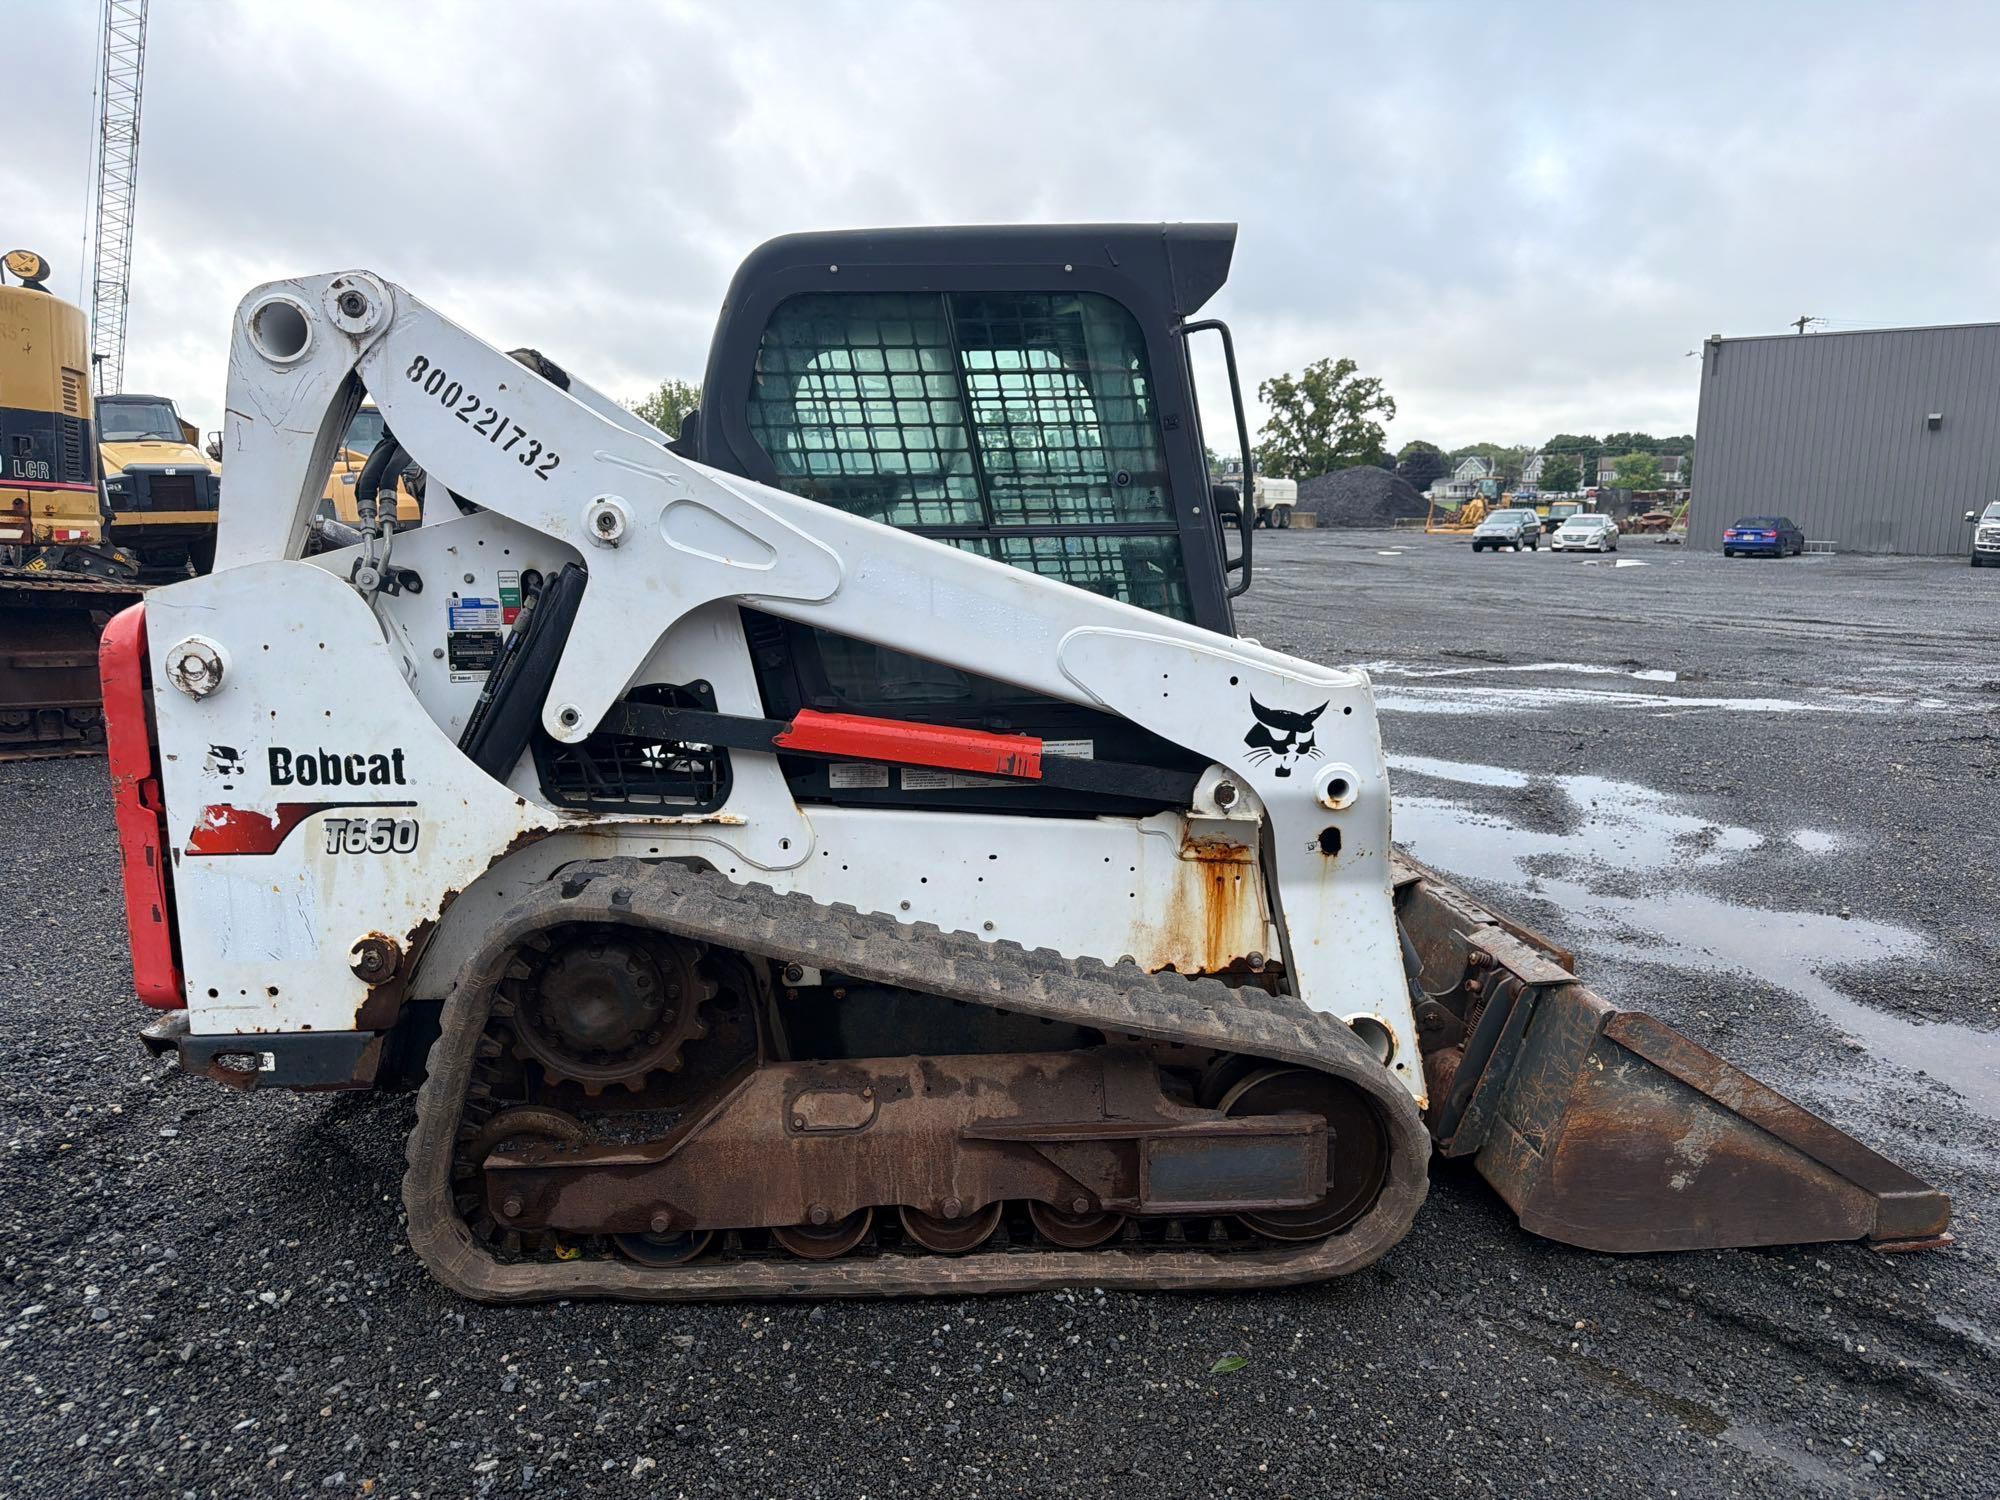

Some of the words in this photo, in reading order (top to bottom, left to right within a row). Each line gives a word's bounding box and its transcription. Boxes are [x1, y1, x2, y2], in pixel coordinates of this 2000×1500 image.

[405, 355, 560, 481] 800221732
[13, 459, 50, 480] LCR
[268, 747, 406, 786] Bobcat
[322, 818, 419, 855] T650
